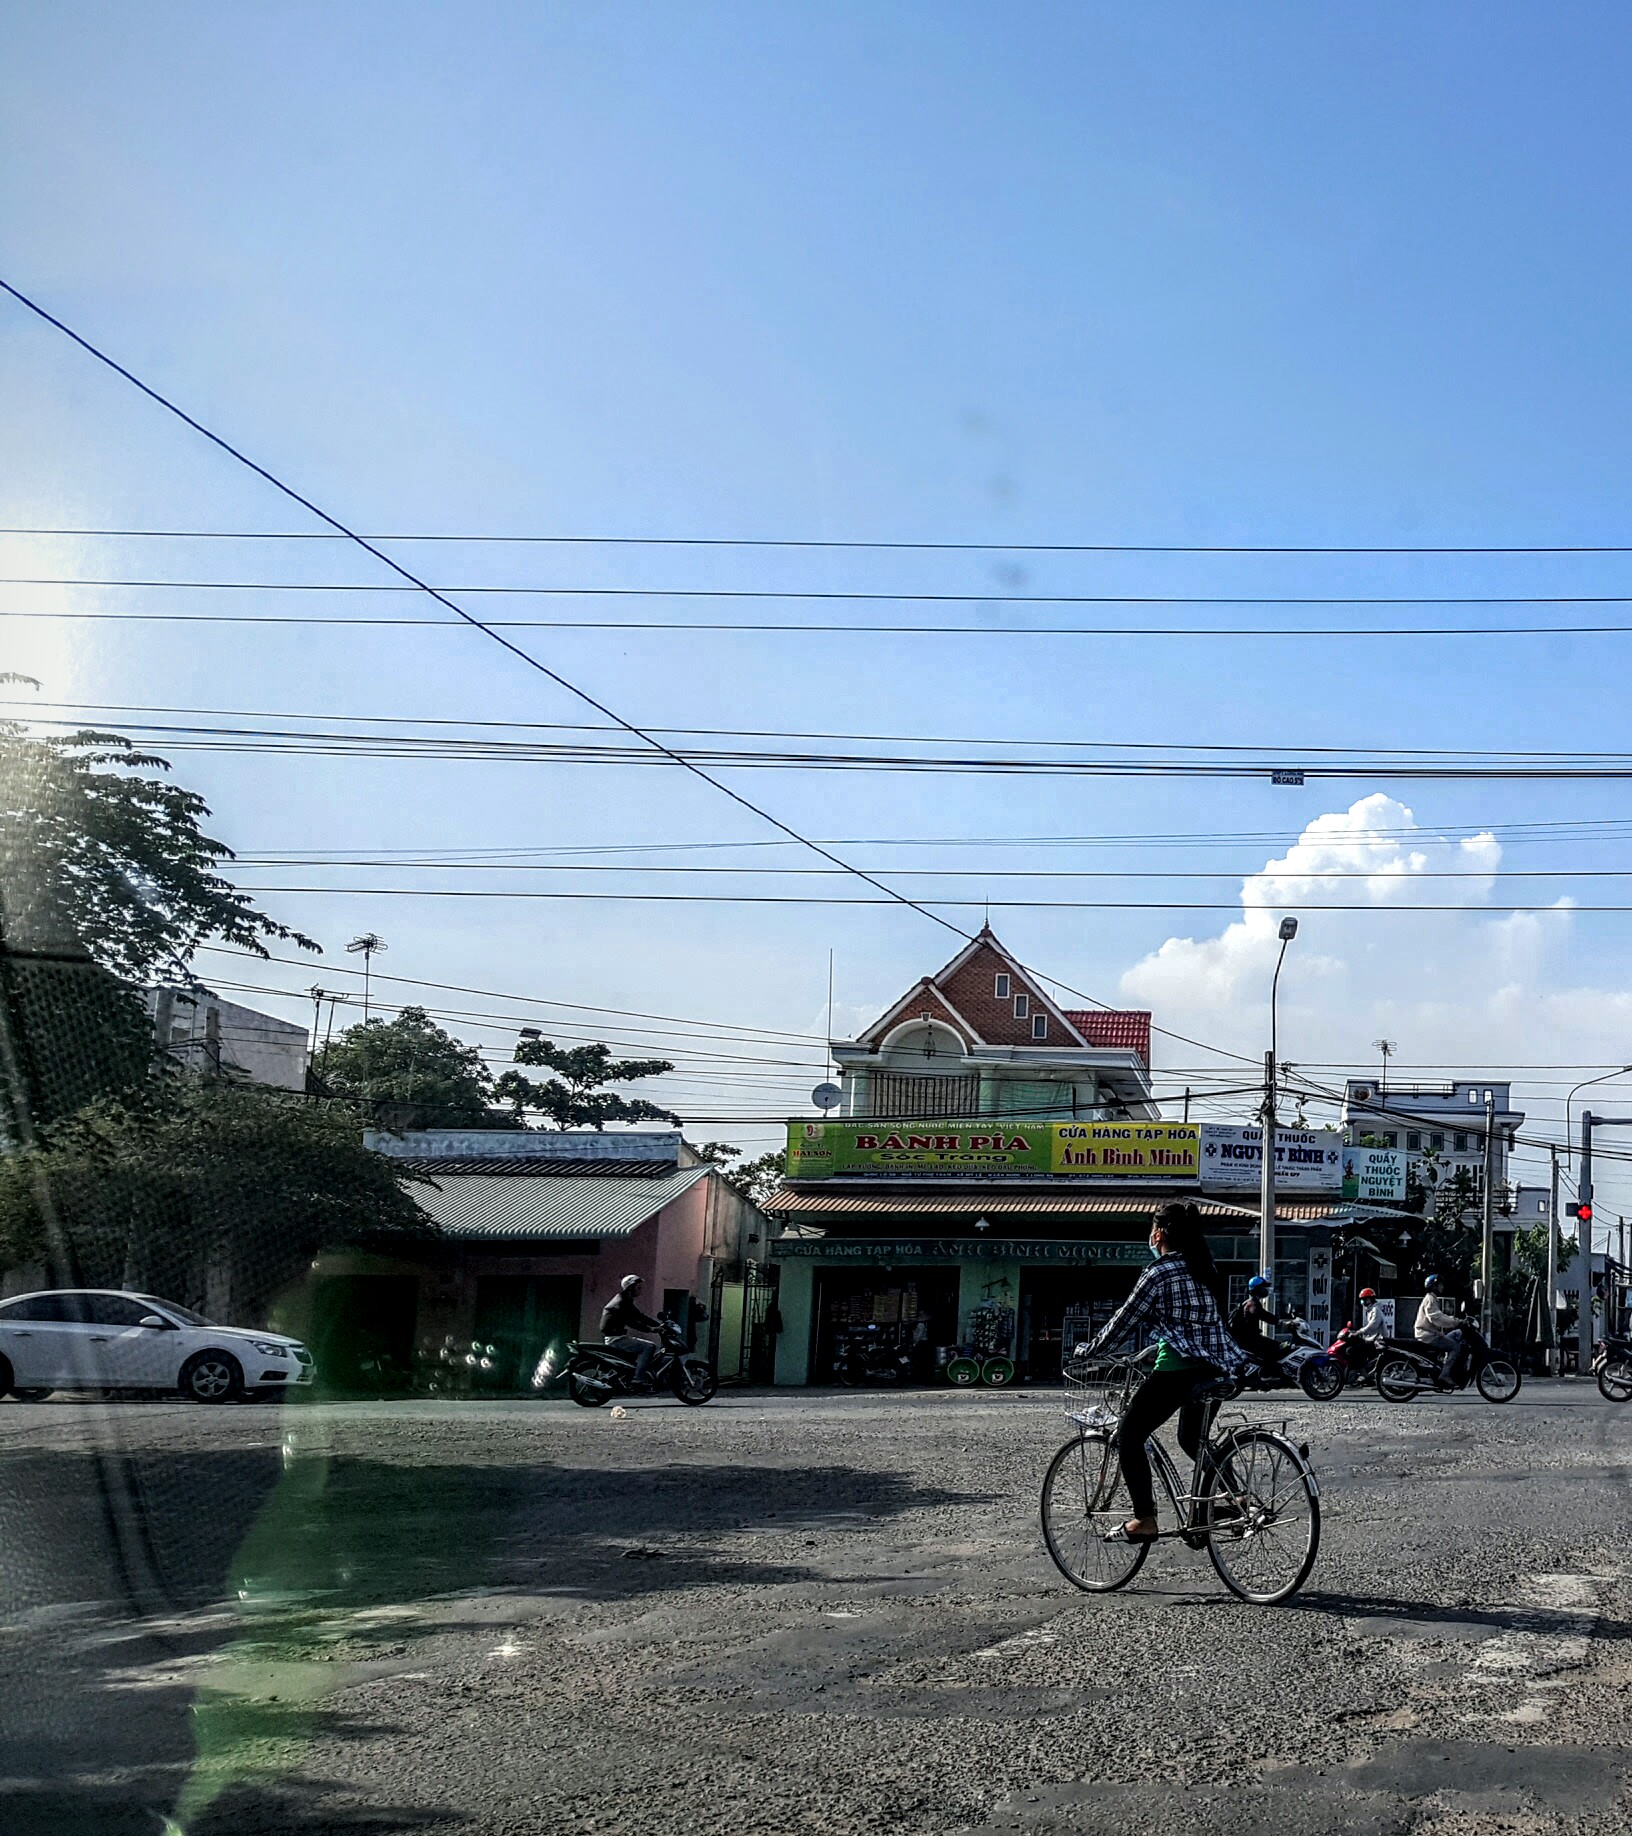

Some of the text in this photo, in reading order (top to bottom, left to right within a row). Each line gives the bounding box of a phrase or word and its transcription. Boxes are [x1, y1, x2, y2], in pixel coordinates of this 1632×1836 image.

[1058, 1125, 1088, 1139] CỬA
[1092, 1126, 1132, 1139] HÀNG
[1135, 1129, 1164, 1142] TẠP
[1167, 1128, 1197, 1140] HÓA
[1277, 1132, 1317, 1145] THUỐC
[855, 1131, 1031, 1152] BÁNH PÍA
[1061, 1142, 1195, 1168] Ánh Bình Minh
[1221, 1143, 1325, 1165] NGUYT BÌNH
[1364, 1163, 1401, 1176] THUỐC
[1360, 1175, 1403, 1187] NGUYỆT
[1368, 1186, 1394, 1198] BÌNH
